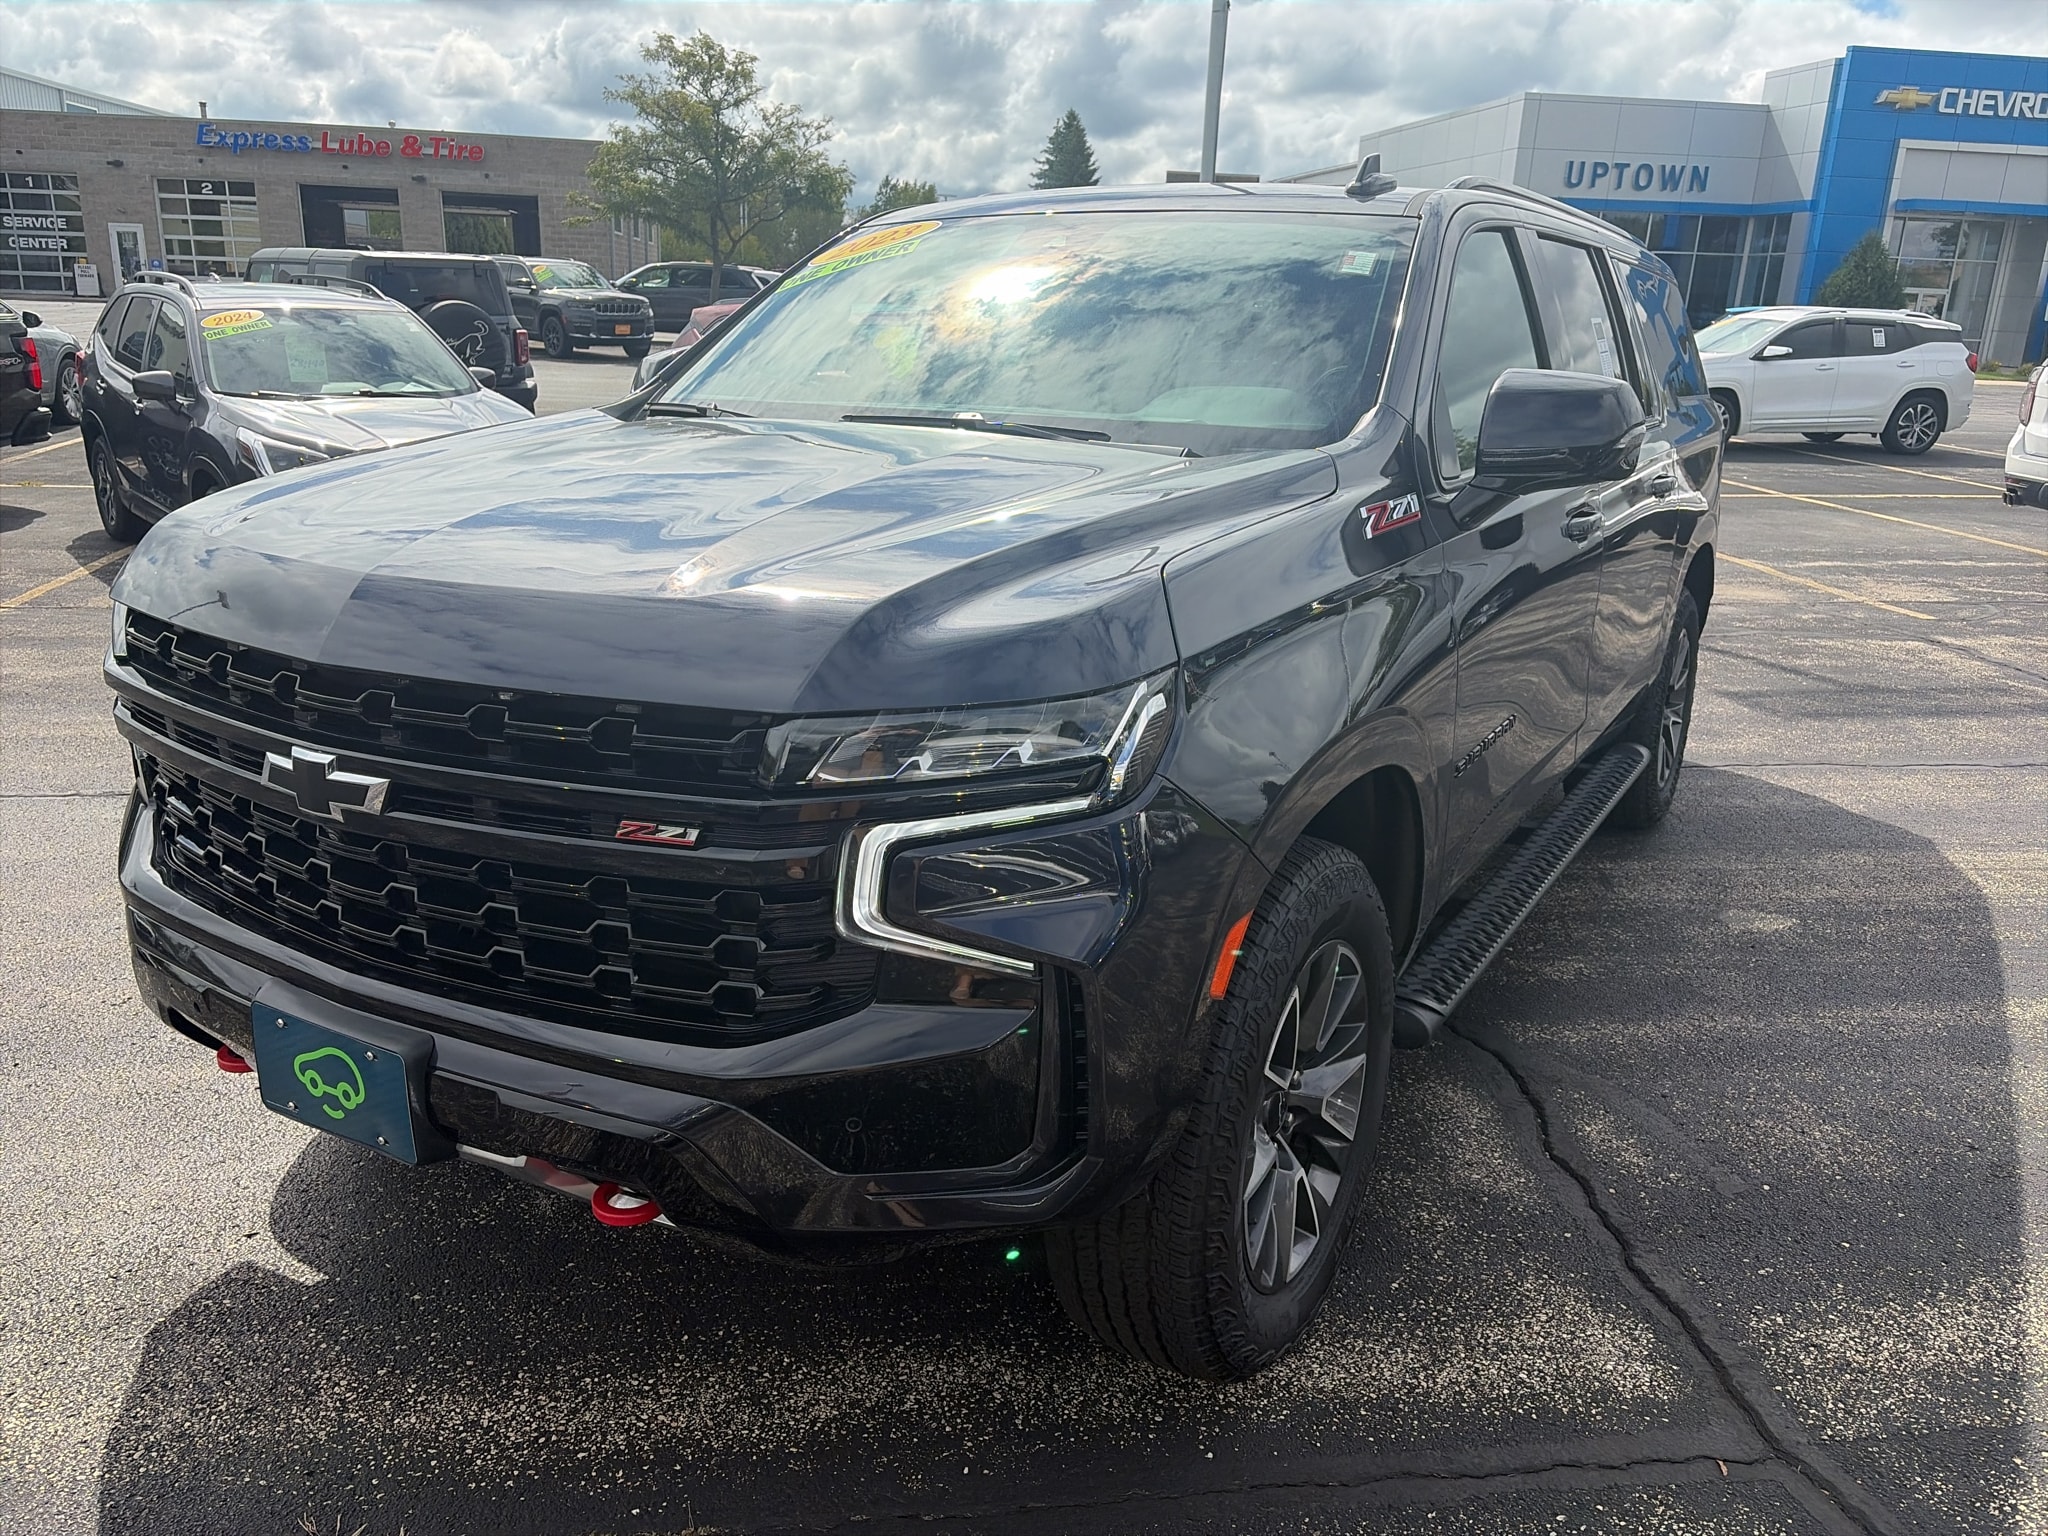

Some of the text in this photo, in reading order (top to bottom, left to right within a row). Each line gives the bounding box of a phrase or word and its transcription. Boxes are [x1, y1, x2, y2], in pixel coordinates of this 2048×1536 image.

[196, 122, 485, 161] Express Lube & Tire
[25, 175, 33, 188] 1
[201, 182, 214, 194] 2
[1565, 159, 1710, 193] UPTOWN
[2, 215, 67, 229] SERVICE
[8, 236, 68, 249] CENTER
[830, 223, 922, 259] 2023
[782, 241, 914, 289] ONE OWNER
[206, 321, 269, 339] ONE OWNER
[213, 311, 253, 326] 2024
[1359, 492, 1421, 540] Z71
[1454, 713, 1518, 778] SUBURBAN
[615, 820, 700, 846] Z71
